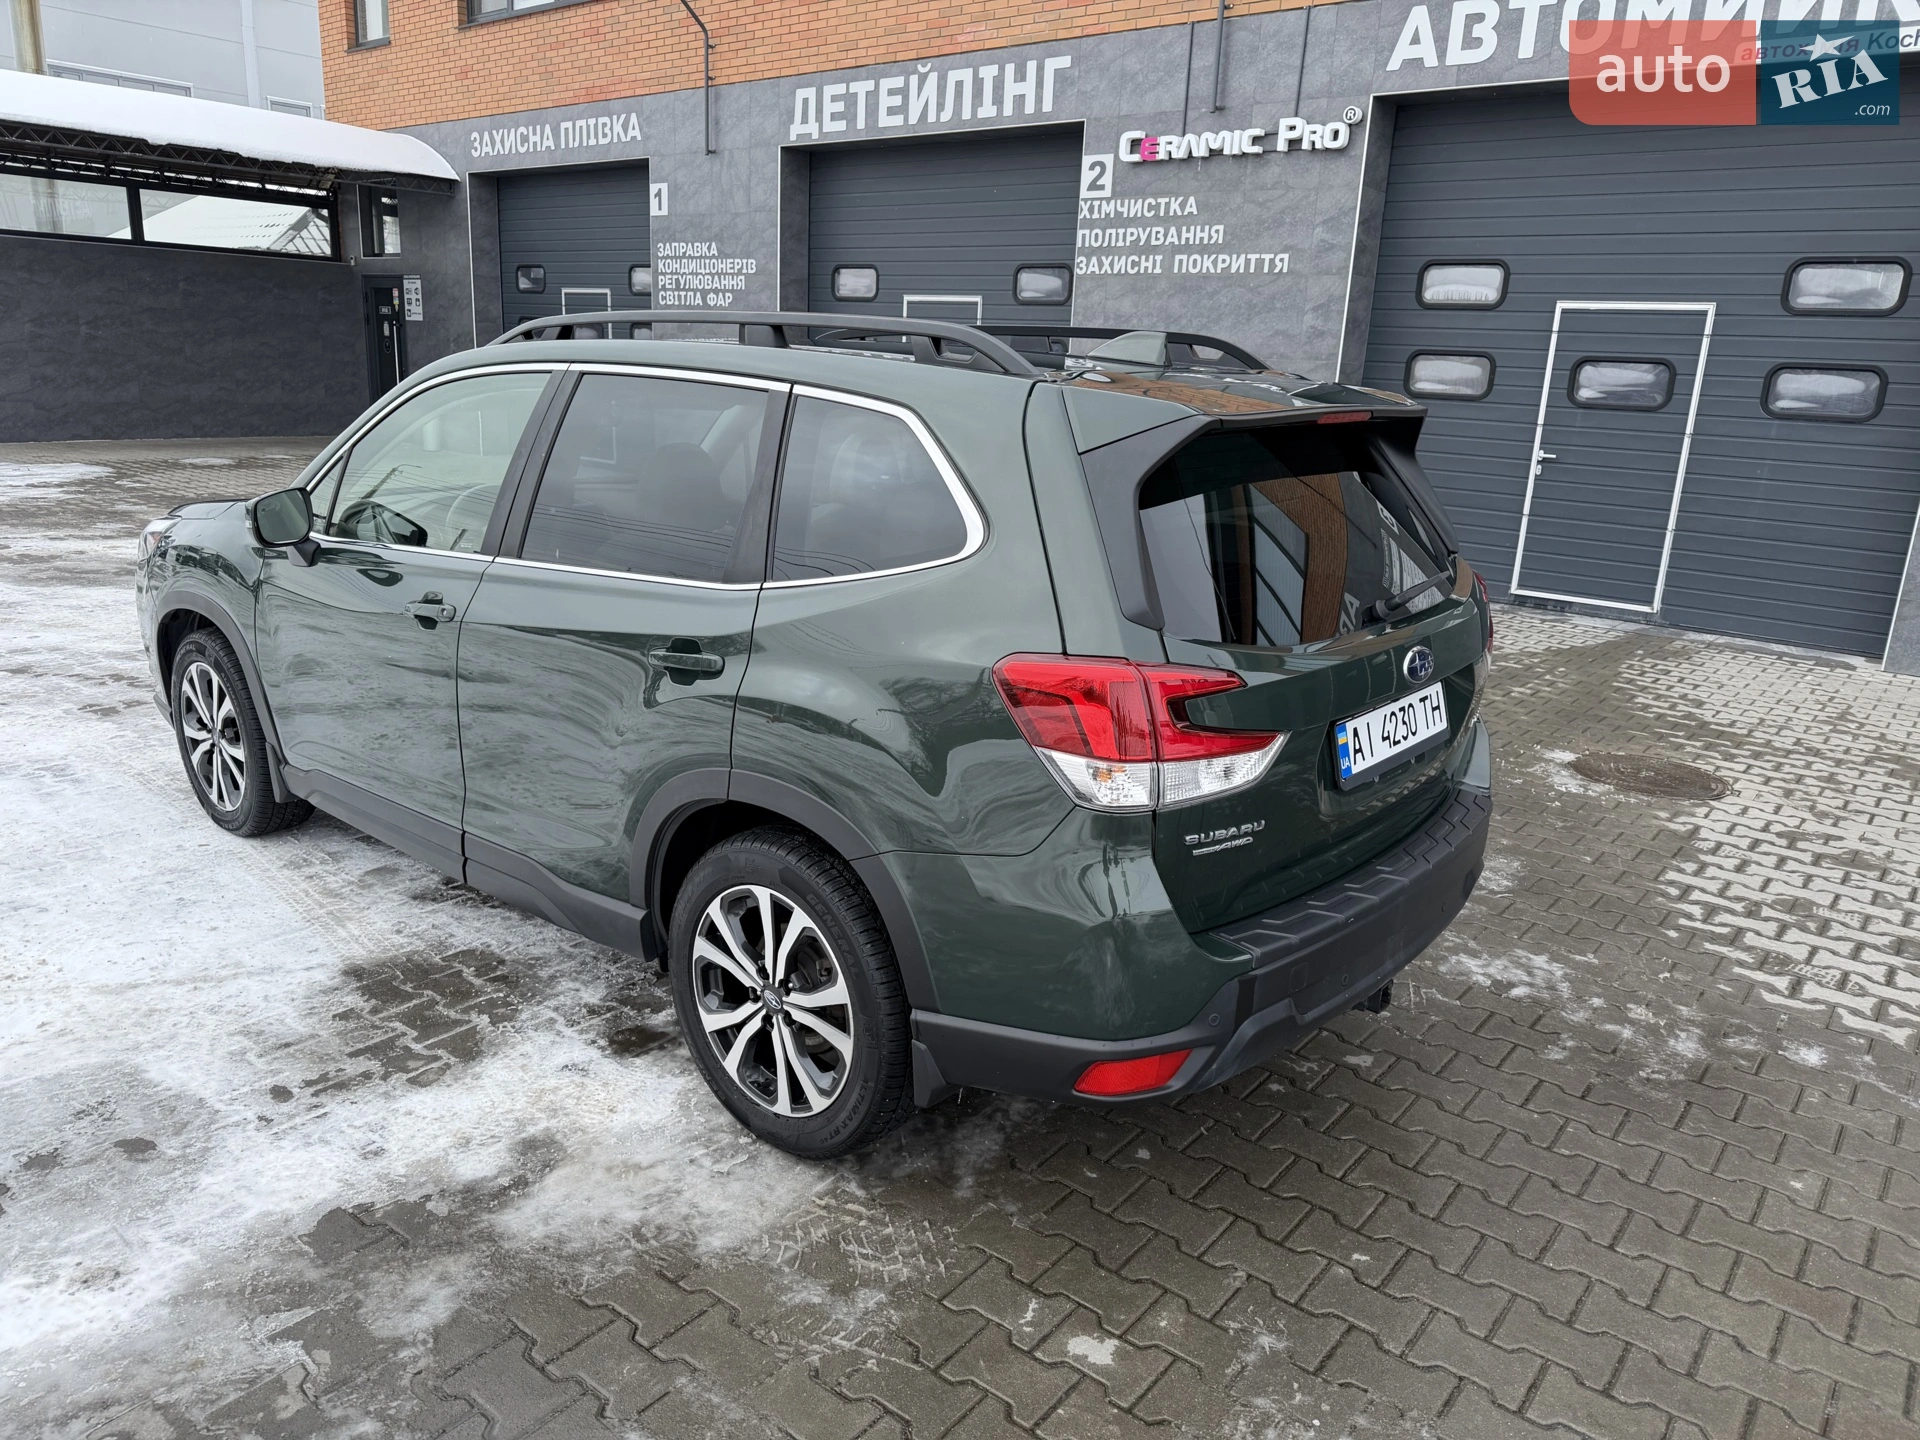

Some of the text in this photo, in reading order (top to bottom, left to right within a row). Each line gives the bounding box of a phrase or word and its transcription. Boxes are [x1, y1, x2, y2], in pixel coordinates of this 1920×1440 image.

[789, 55, 1072, 142] ДЕТЕЙЛІНГ
[470, 112, 642, 158] ЗАХИСНА ПЛІВКА
[1086, 160, 1107, 193] 2
[653, 187, 663, 212] 1
[1079, 196, 1198, 220] ХІМЧИСТКА
[1077, 224, 1225, 248] ПОЛІРУВАННЯ
[657, 241, 718, 257] ЗАПРАВКА
[658, 258, 757, 275] КОНДИЦІОНЕРІВ
[1075, 253, 1290, 275] ЗАХИСНІ ПОКРИТТЯ
[658, 274, 745, 290] РЕГУЛЮВАННЯ
[658, 291, 733, 307] СВІТЛА ФАР
[1352, 690, 1443, 766] AI 4230 TH
[1340, 756, 1351, 770] UA
[1184, 819, 1266, 846] SUBARU
